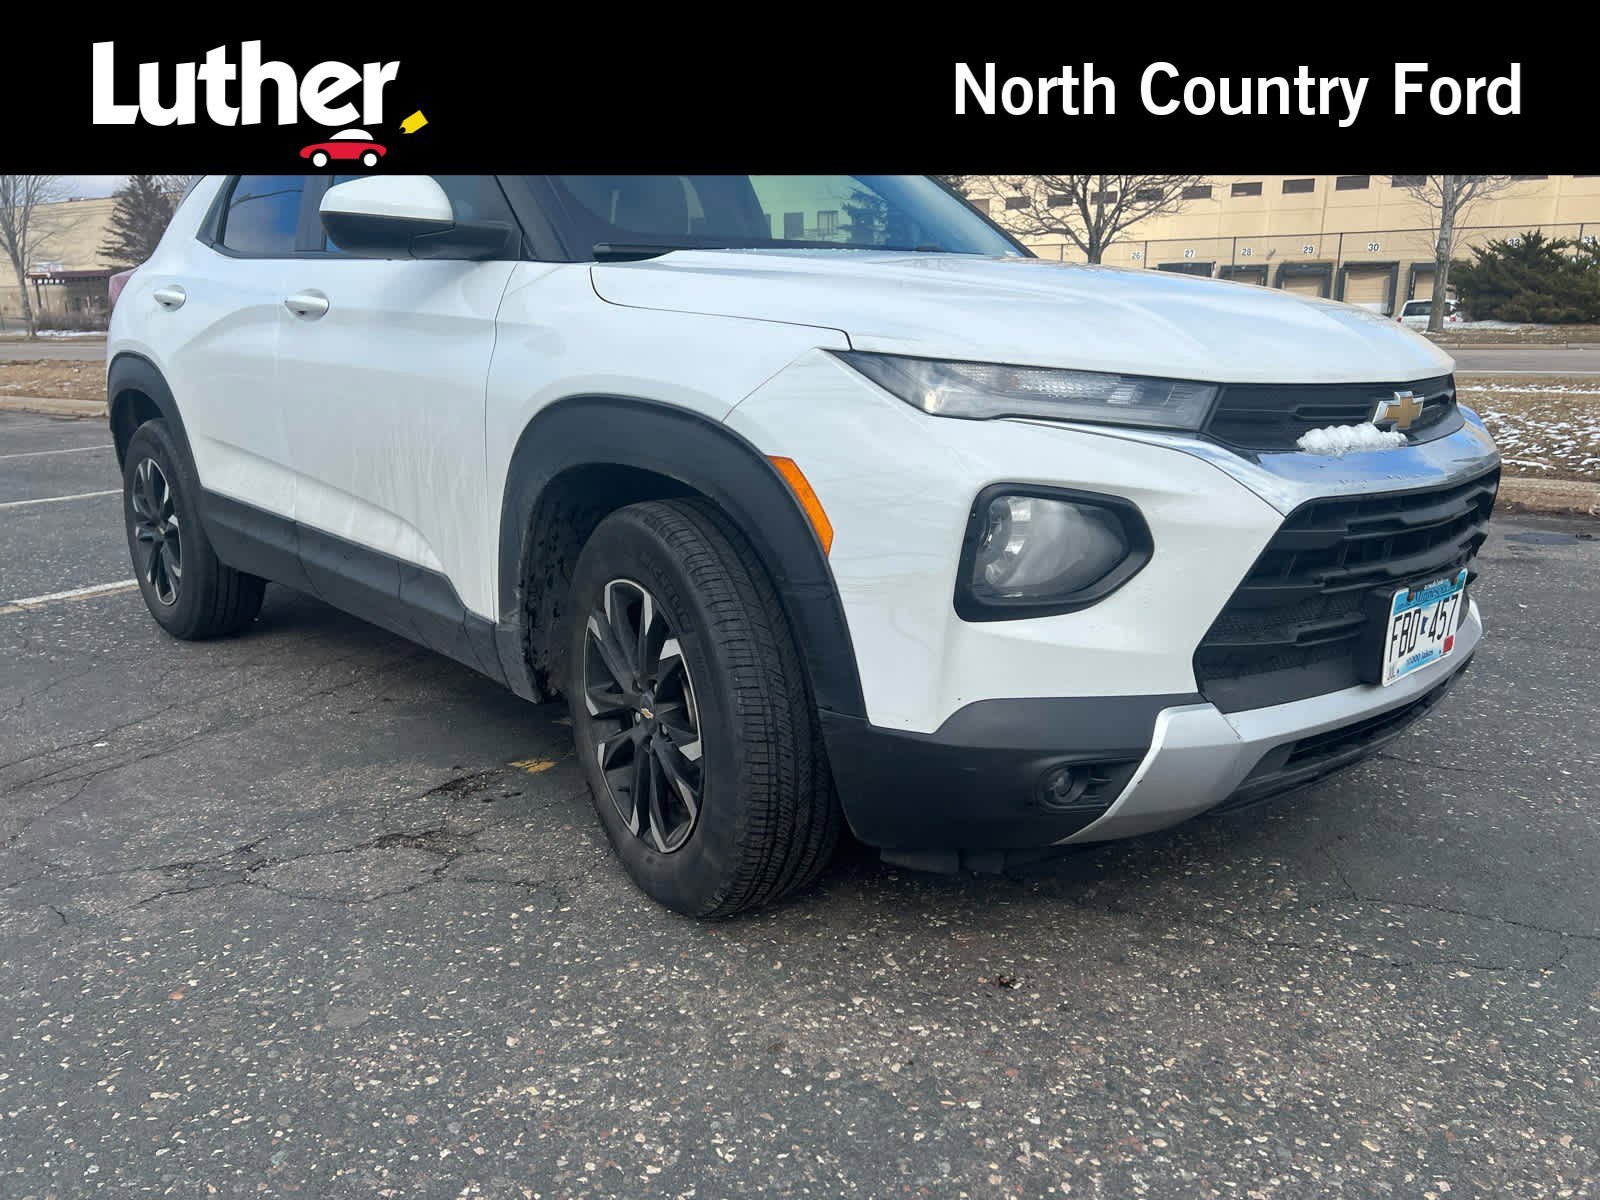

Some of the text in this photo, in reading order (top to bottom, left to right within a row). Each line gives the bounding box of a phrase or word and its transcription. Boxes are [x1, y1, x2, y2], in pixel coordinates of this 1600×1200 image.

[1241, 248, 1252, 256] 28
[1303, 246, 1314, 254] 29
[1368, 243, 1379, 252] 30
[1184, 249, 1194, 258] 27
[1389, 594, 1458, 662] FBD 457
